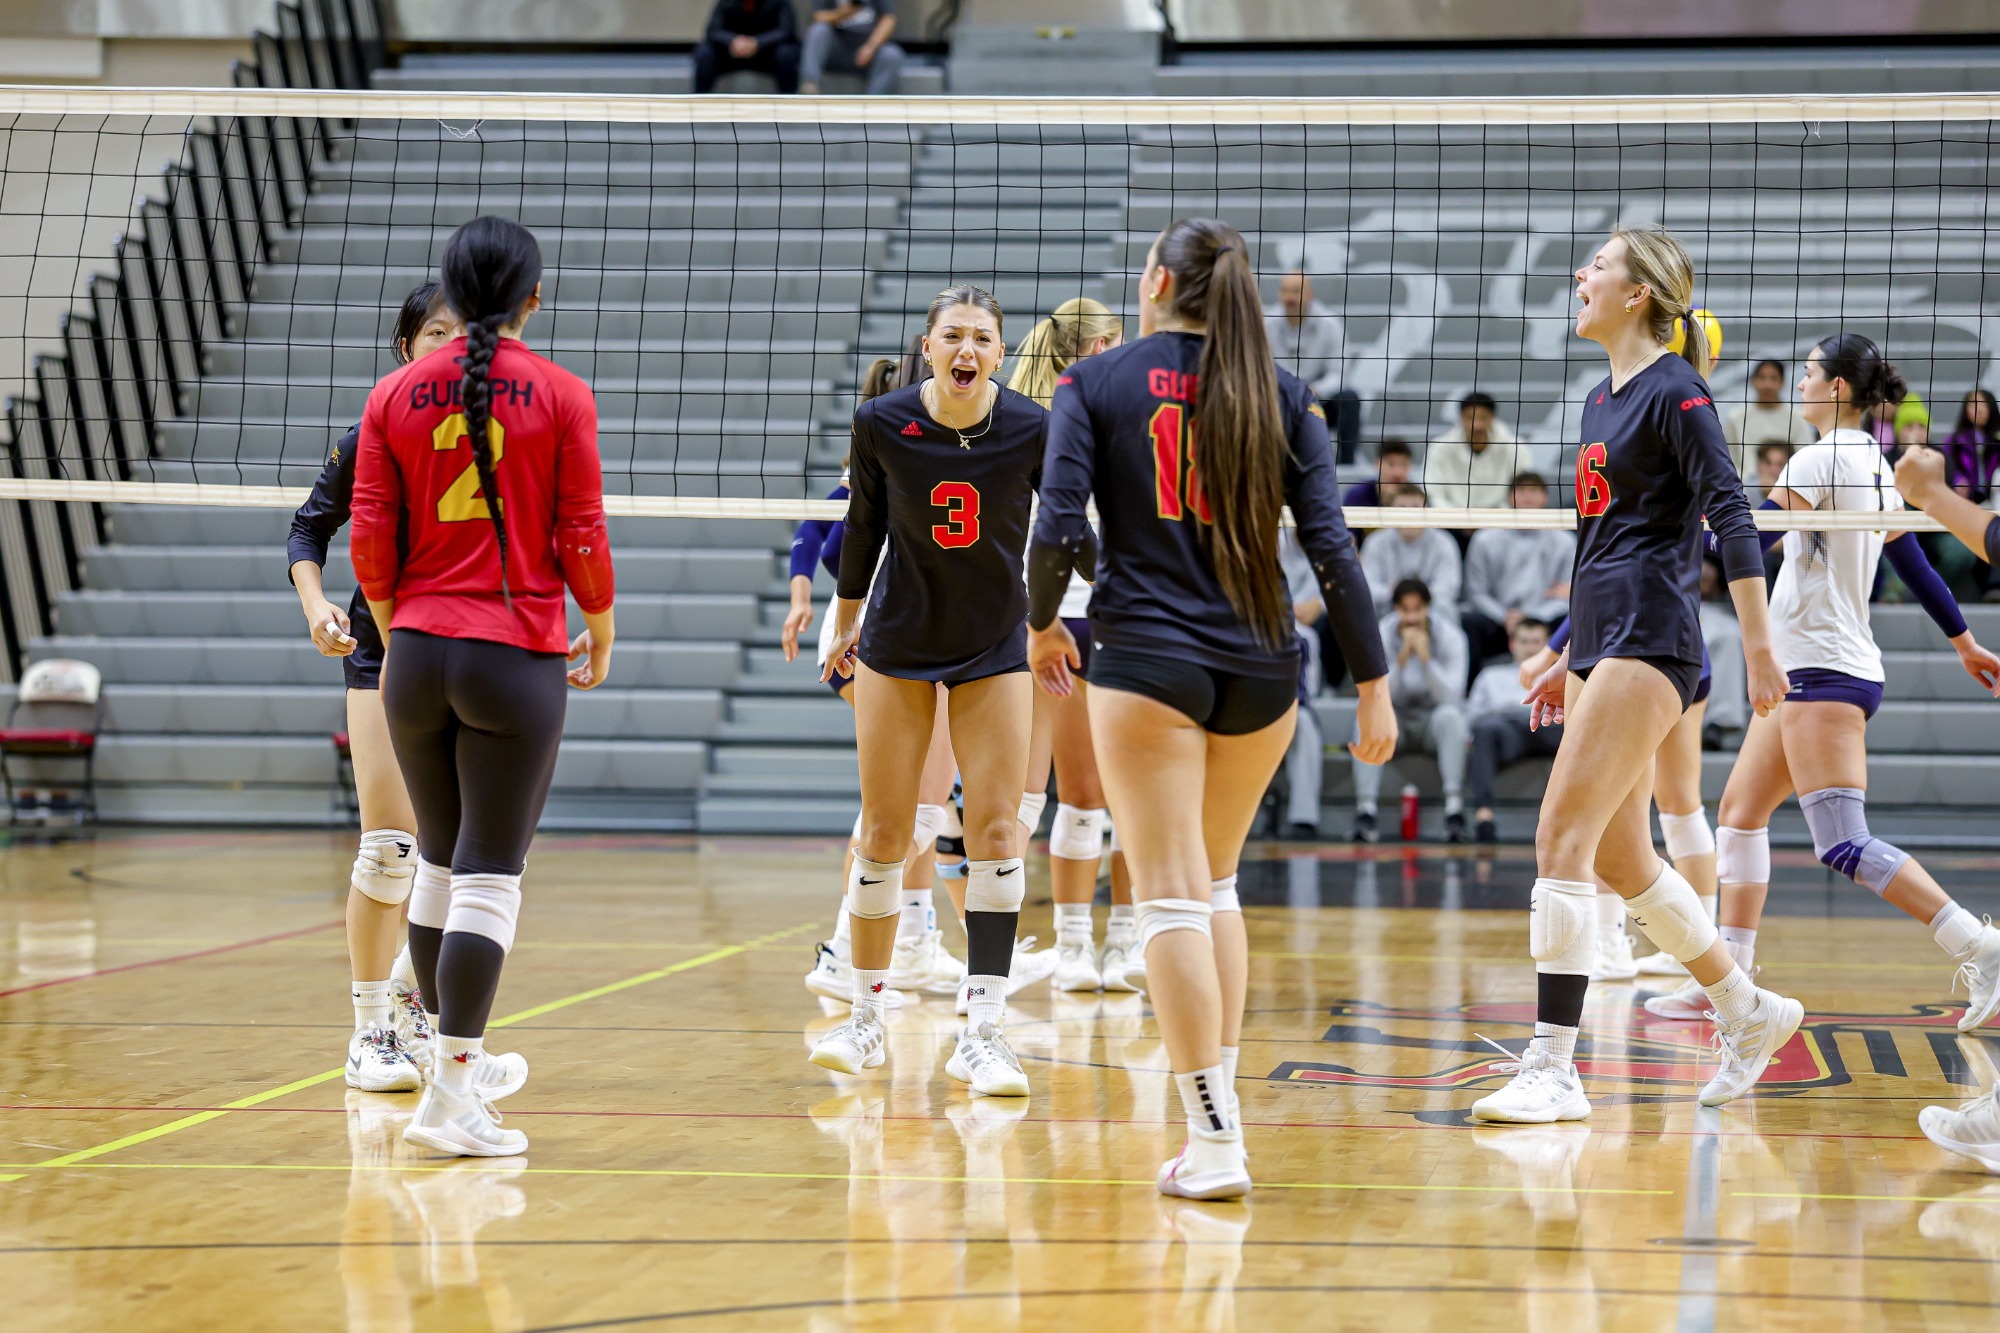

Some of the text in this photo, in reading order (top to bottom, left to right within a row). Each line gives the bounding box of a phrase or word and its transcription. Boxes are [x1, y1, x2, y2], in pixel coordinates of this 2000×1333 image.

[411, 379, 533, 410] GUEPH
[432, 413, 505, 523] 2
[931, 481, 981, 549] 3
